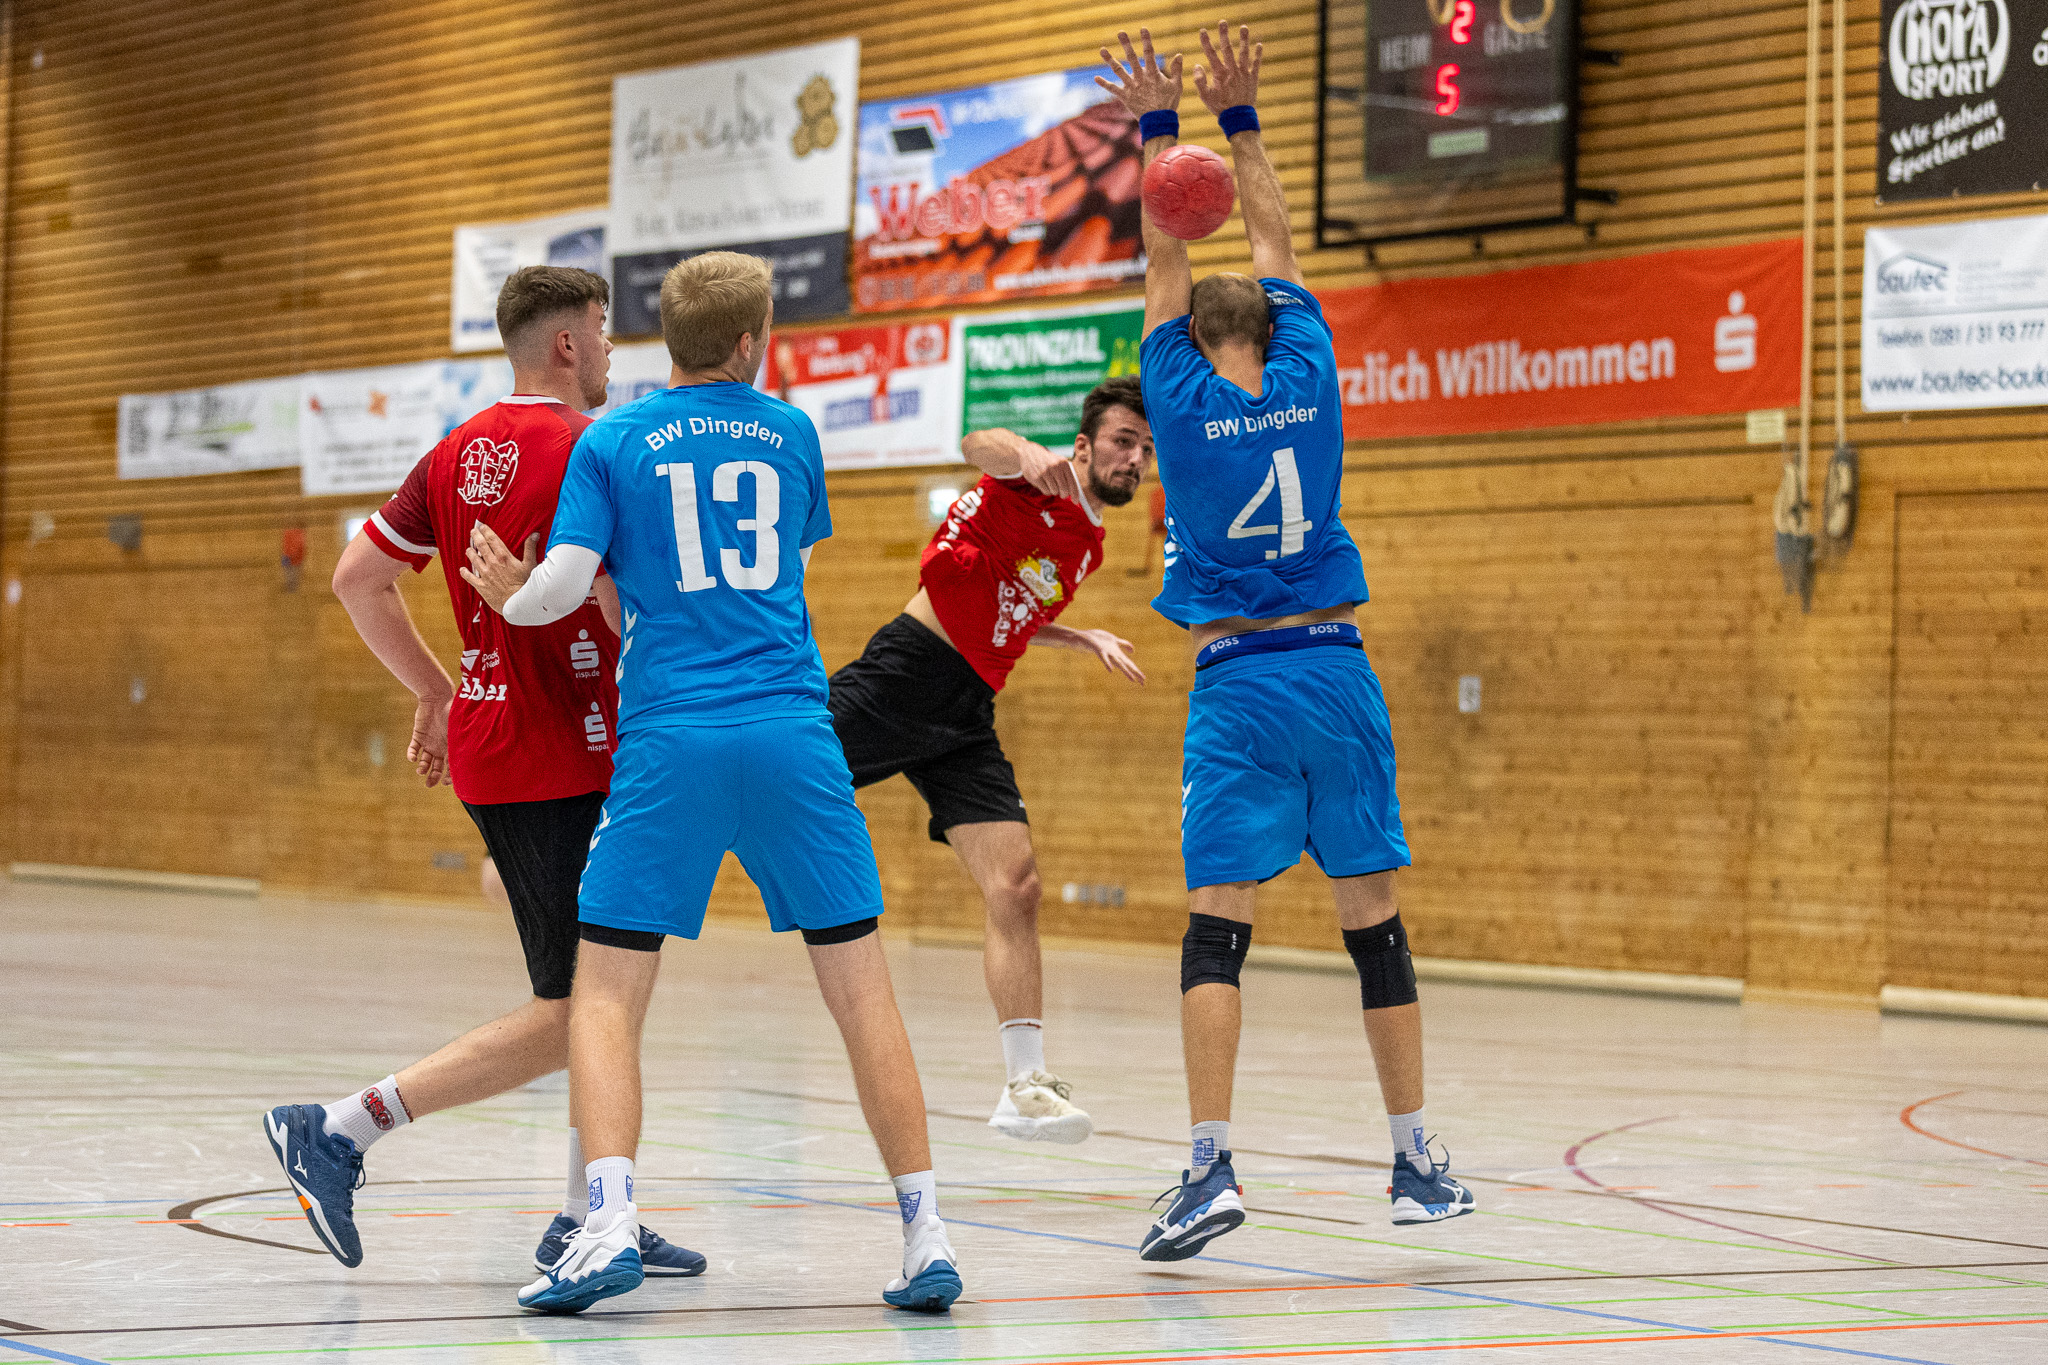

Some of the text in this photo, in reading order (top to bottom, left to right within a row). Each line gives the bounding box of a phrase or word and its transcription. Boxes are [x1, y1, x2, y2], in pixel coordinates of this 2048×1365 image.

[1435, 63, 1460, 116] 5
[1910, 58, 1986, 100] SPORT
[869, 178, 1049, 242] Weber
[967, 328, 1105, 370] PROVINZIAL
[1437, 336, 1675, 399] Willkommen
[645, 417, 783, 451] BW Dingden
[1205, 405, 1317, 440] BW Dingden
[1227, 447, 1313, 560] 4
[655, 461, 780, 592] 13
[1210, 637, 1239, 653] BOSS
[1309, 624, 1339, 635] BOSS
